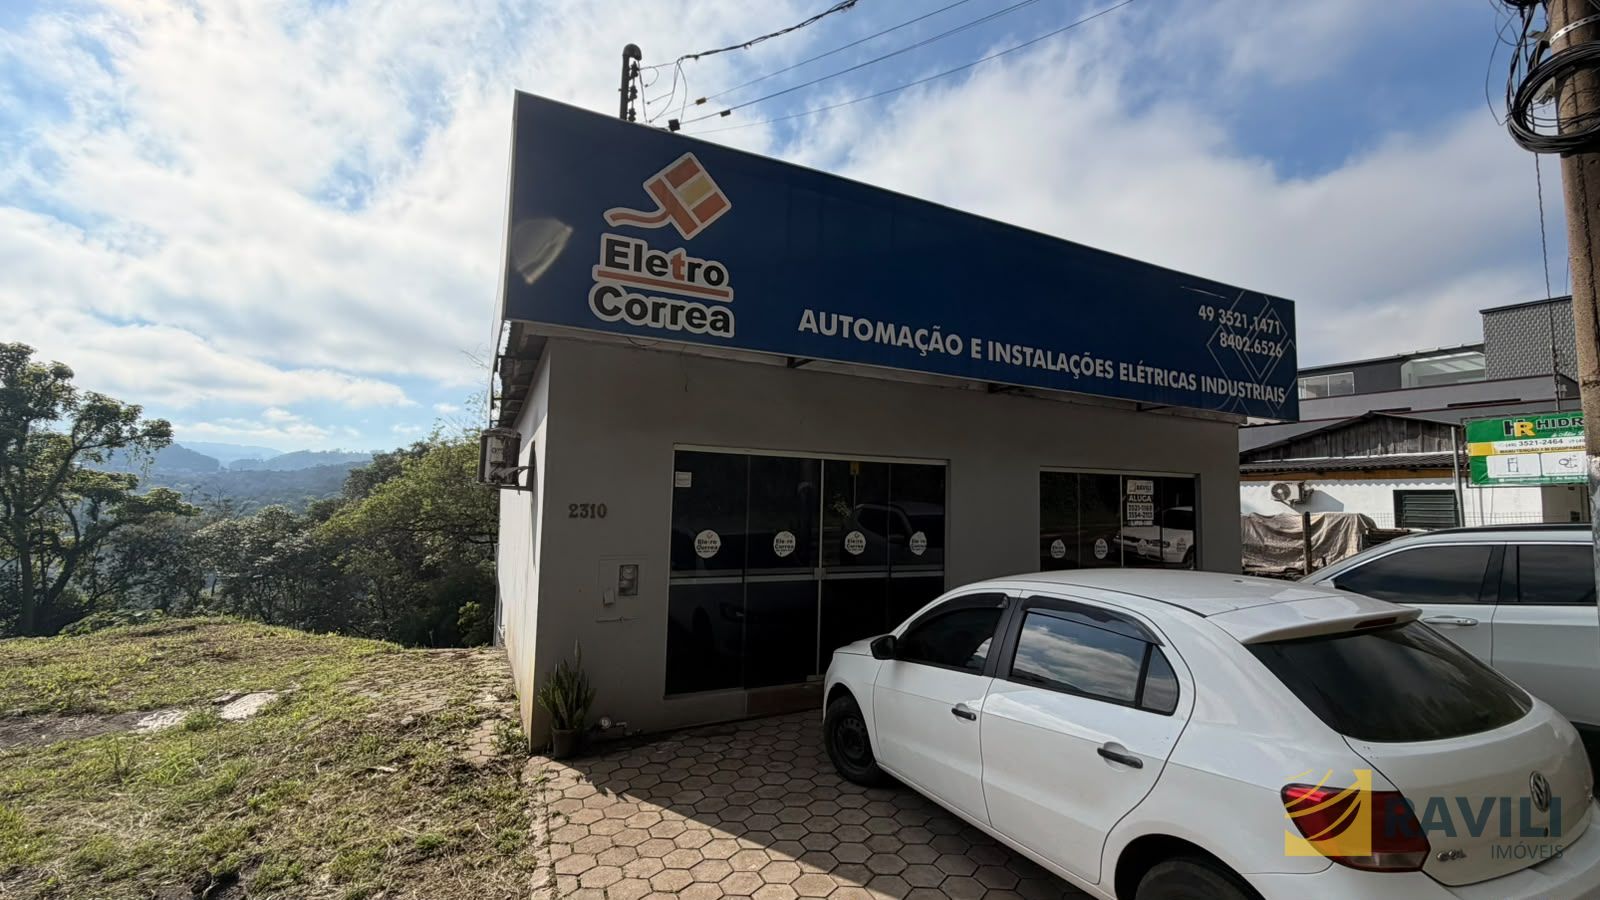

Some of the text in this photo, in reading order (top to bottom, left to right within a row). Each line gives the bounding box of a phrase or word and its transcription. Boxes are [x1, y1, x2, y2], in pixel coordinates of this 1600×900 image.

[604, 237, 725, 287] Eletro
[593, 285, 731, 334] Correa
[1198, 304, 1281, 335] 49 3521.1471
[798, 308, 1286, 403] AUTOMAÇÃO E INSTALAÇÕES ELÉTRICAS INDUSTRIAIS
[1219, 331, 1283, 358] 8402.6526
[1518, 438, 1564, 447] 3521-2464
[568, 503, 608, 519] 2310
[1128, 494, 1152, 503] ALUGA
